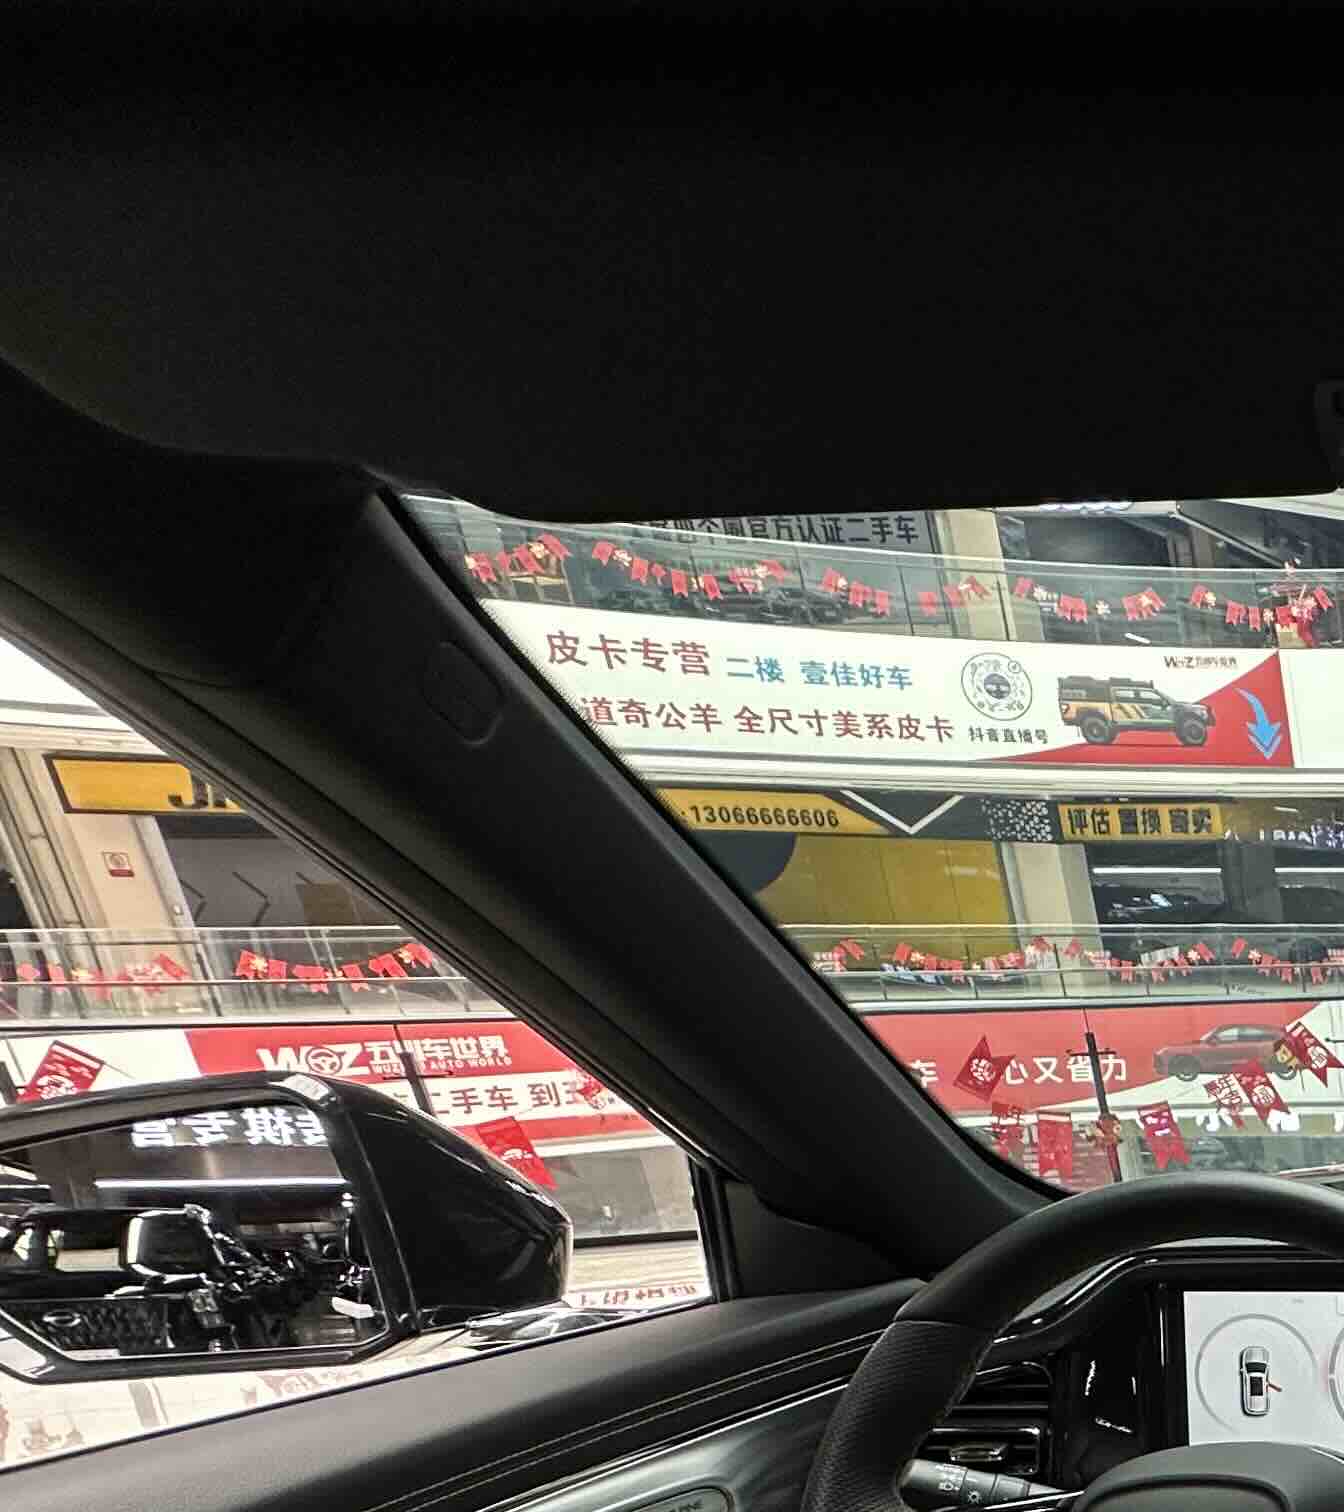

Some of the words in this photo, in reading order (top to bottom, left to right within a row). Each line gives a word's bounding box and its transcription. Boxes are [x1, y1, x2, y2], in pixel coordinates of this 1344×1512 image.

[546, 630, 710, 677] 皮卡专营
[726, 655, 786, 684] 二楼
[799, 659, 913, 691] 壹佳好车
[579, 698, 722, 733] 道奇公羊
[733, 704, 956, 743] 全尺寸美系皮卡
[968, 726, 1049, 745] 抖音直播号
[690, 805, 840, 828] 13066666606
[1068, 808, 1111, 834] 评估
[432, 1060, 464, 1070] AUTO
[467, 1056, 513, 1068] WORLD
